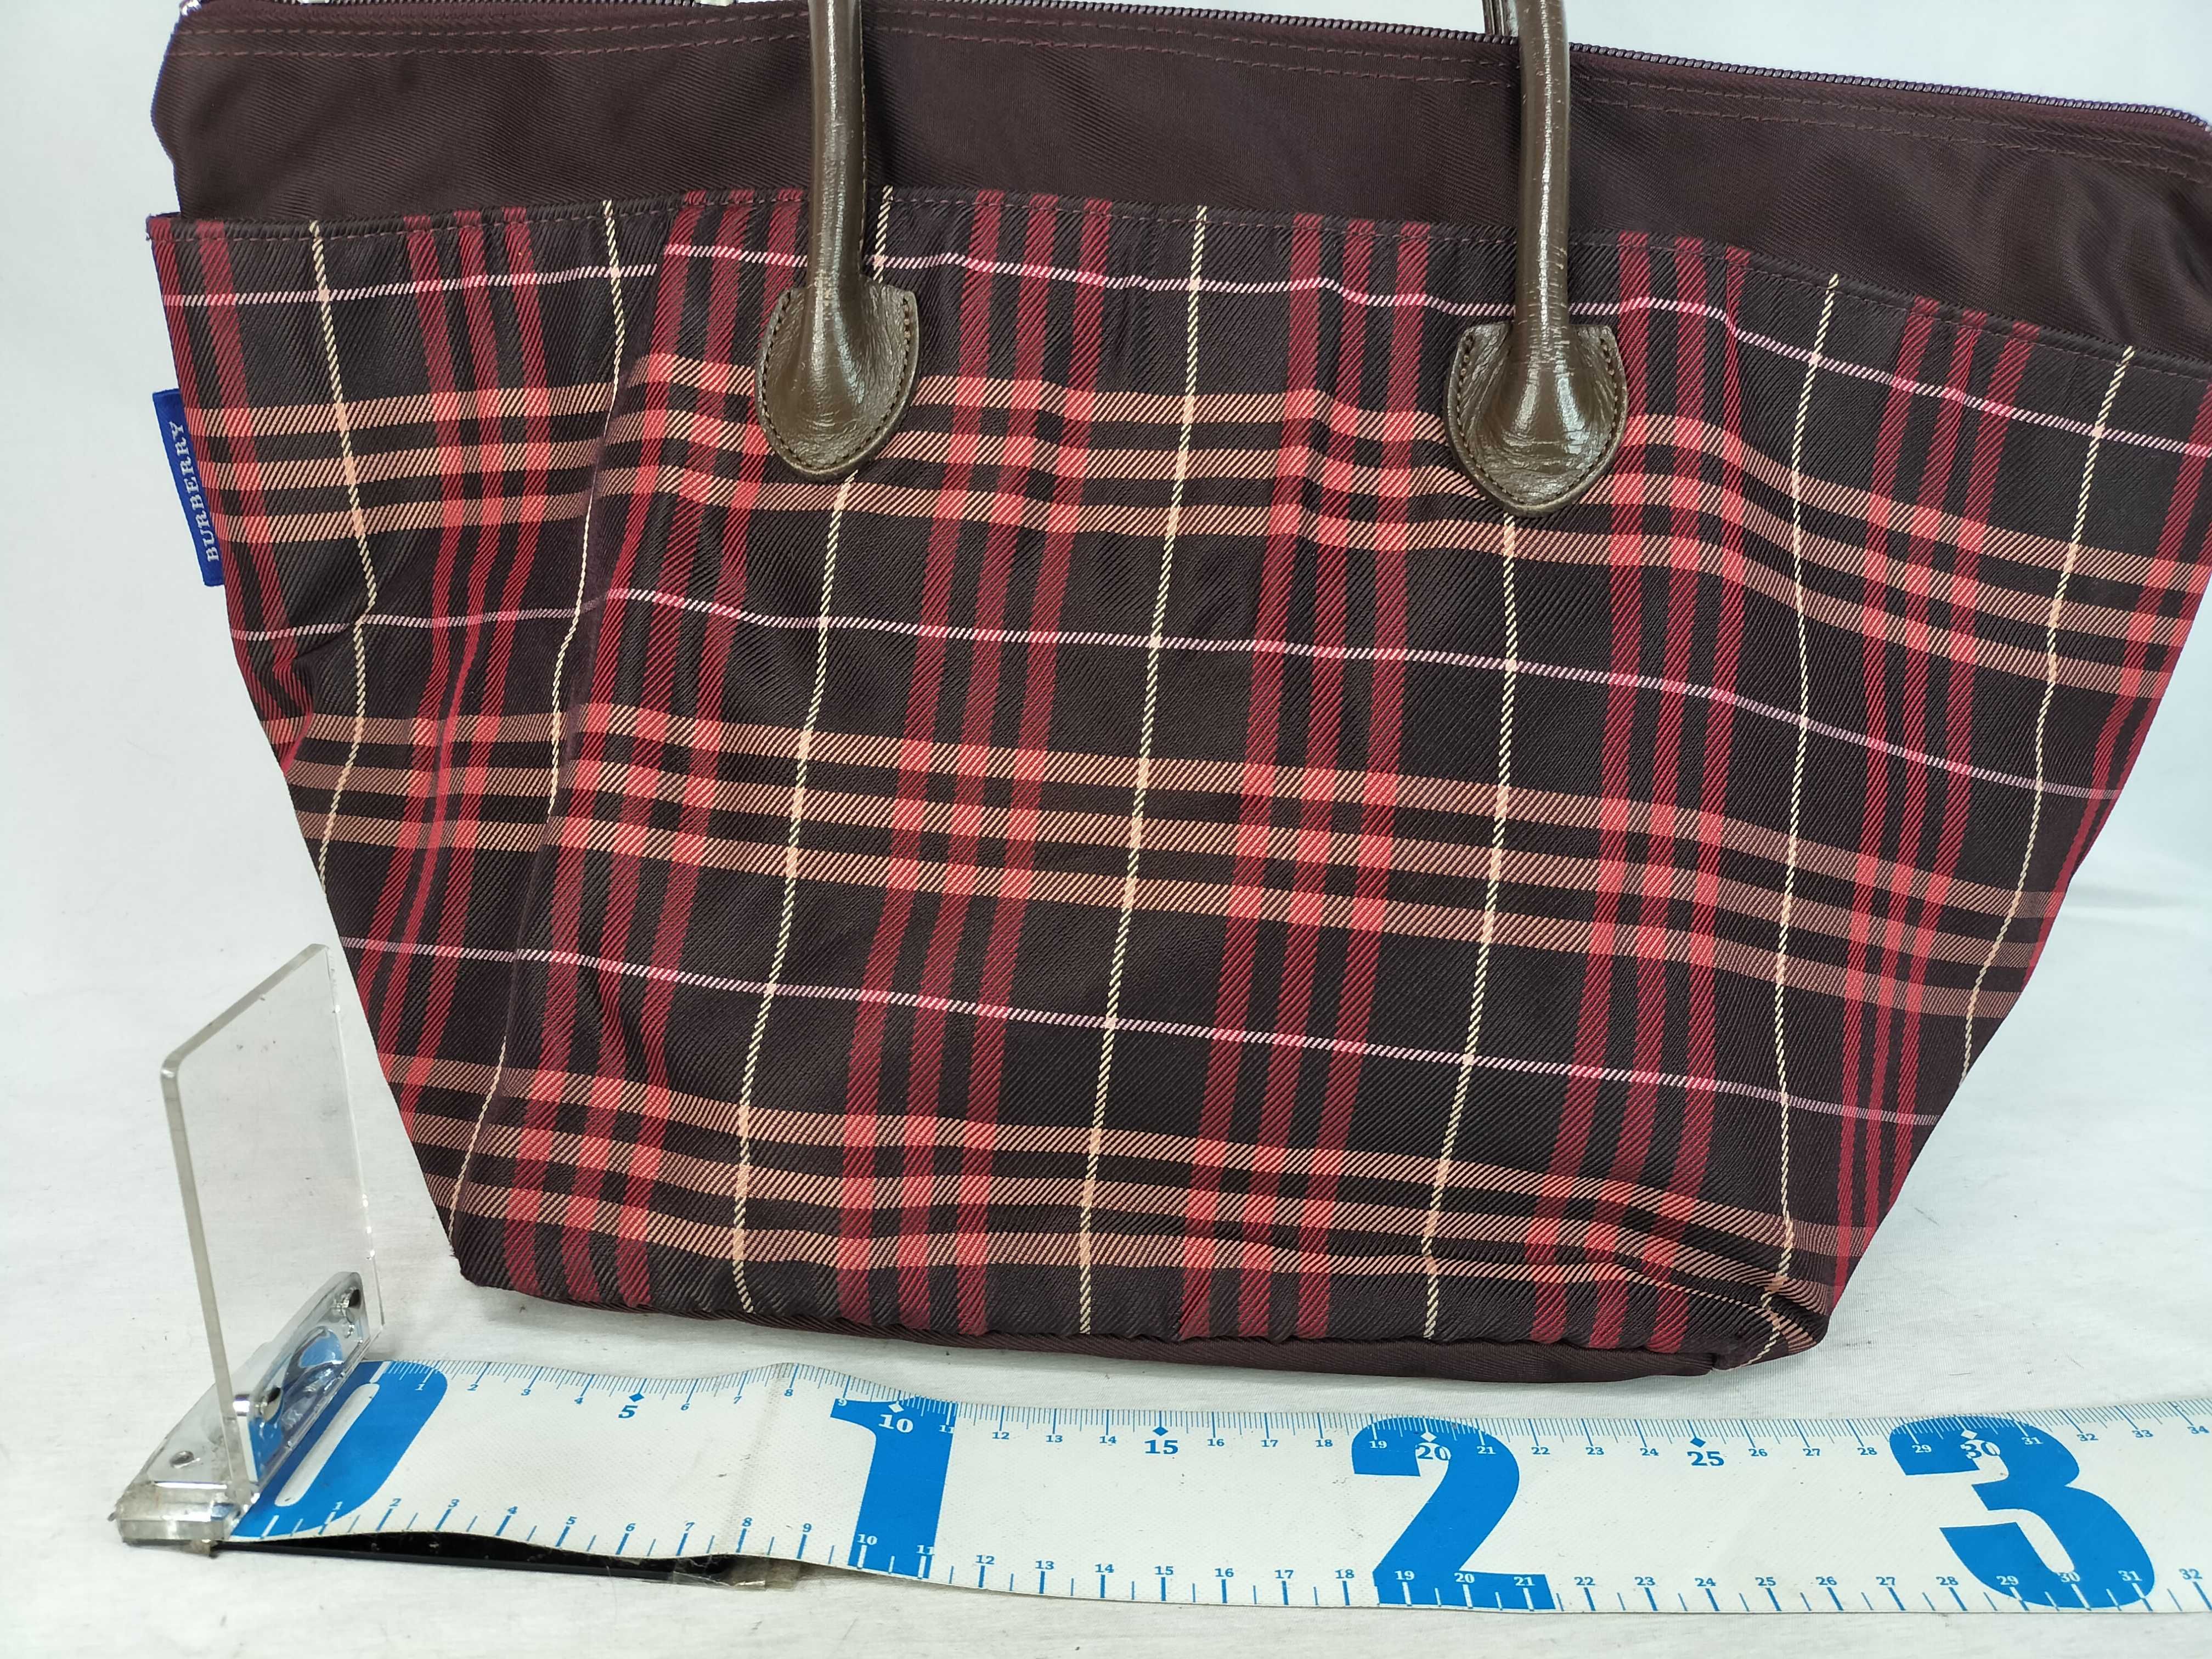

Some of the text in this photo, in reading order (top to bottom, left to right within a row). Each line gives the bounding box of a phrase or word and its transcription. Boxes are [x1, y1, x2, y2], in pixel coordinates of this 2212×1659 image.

[169, 421, 219, 562] BURBERRY
[618, 1406, 638, 1418] 5
[878, 1414, 913, 1433] 10
[939, 1425, 954, 1433] 11
[1144, 1440, 1178, 1454] 15
[1207, 1438, 1224, 1447] 16
[1416, 1445, 1451, 1461] 20
[1477, 1447, 1496, 1455] 21
[1532, 1447, 1550, 1455] 22
[1585, 1447, 1604, 1455] 23
[1640, 1448, 1658, 1456] 24
[1688, 1452, 1724, 1466] 25
[1858, 1447, 1877, 1455] 28
[1961, 1442, 2000, 1459] 30
[2022, 1437, 2043, 1446] 31
[2076, 1433, 2098, 1442] 32
[2132, 1430, 2153, 1438] 33
[2188, 1426, 2209, 1435] 34
[333, 1498, 2202, 1587] 1 2 3 4 5 6 7 8 9 10 11 12 13 14 15 16 17 18 19 20 21 22 23 24 25 26 27 28 29 30 31 32
[831, 1398, 957, 1578] 1
[1351, 1417, 1556, 1610] 2
[1889, 1415, 2155, 1609] 3
